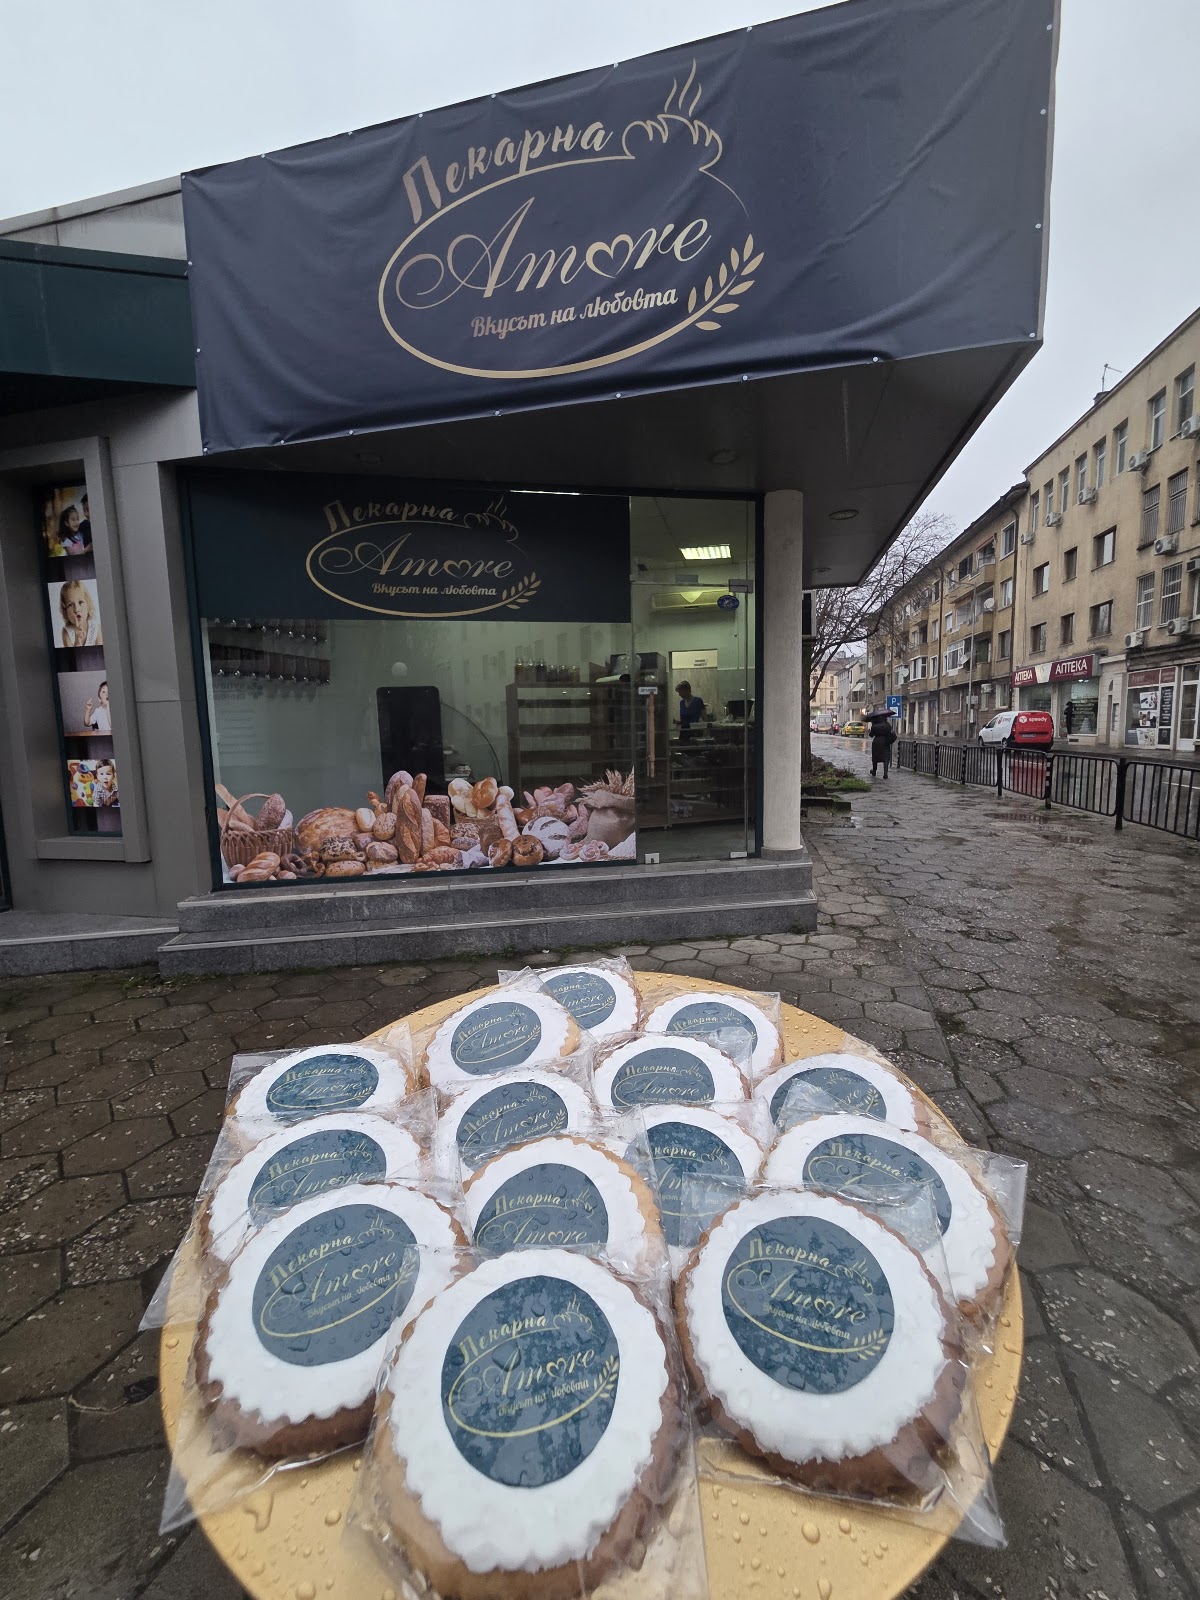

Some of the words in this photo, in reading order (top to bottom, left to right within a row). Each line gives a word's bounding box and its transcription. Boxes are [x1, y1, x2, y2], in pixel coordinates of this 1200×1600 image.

[402, 121, 614, 224] Пекарна
[396, 197, 712, 309] Amore
[471, 312, 548, 340] Вкусът
[550, 305, 576, 325] на
[579, 287, 679, 320] любовта
[323, 499, 458, 532] Пекарна
[318, 533, 514, 579] Amore
[372, 583, 420, 597] Вкусът
[422, 586, 439, 595] на
[441, 584, 498, 596] любовта
[1014, 669, 1033, 683] АПТЕКА
[1055, 659, 1088, 675] АПТЕКА
[891, 697, 897, 705] P
[654, 1146, 697, 1158] карна
[830, 1142, 901, 1176] Пекарна
[495, 1193, 563, 1216] Пекарна
[268, 1235, 355, 1288] Пекарна
[749, 1238, 834, 1268] Пекарна
[458, 1315, 551, 1364] Пекарна
